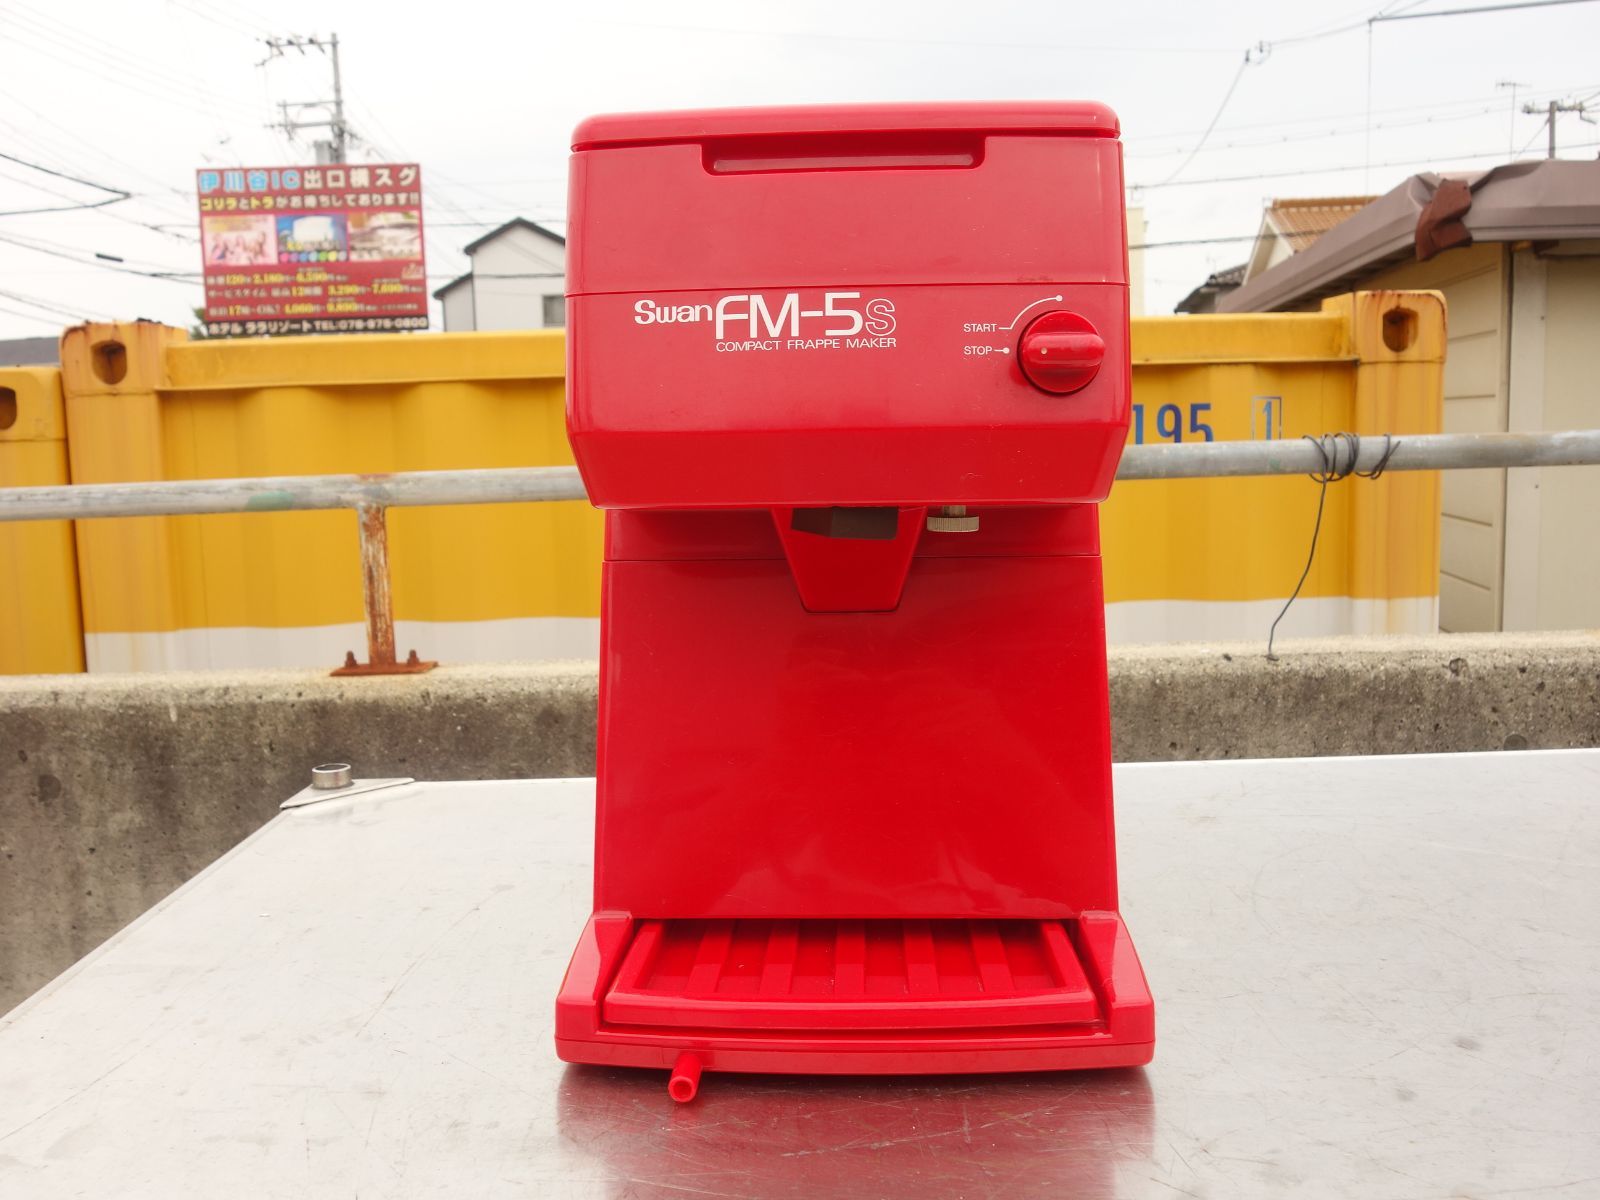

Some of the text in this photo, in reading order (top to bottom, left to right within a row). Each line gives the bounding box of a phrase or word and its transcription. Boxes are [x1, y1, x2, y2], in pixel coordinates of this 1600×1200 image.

[634, 299, 713, 325] Swan
[963, 323, 998, 333] START
[716, 337, 897, 353] COMPACT FRAPPE MAKER
[963, 345, 993, 355] STOP
[1132, 402, 1214, 445] 195
